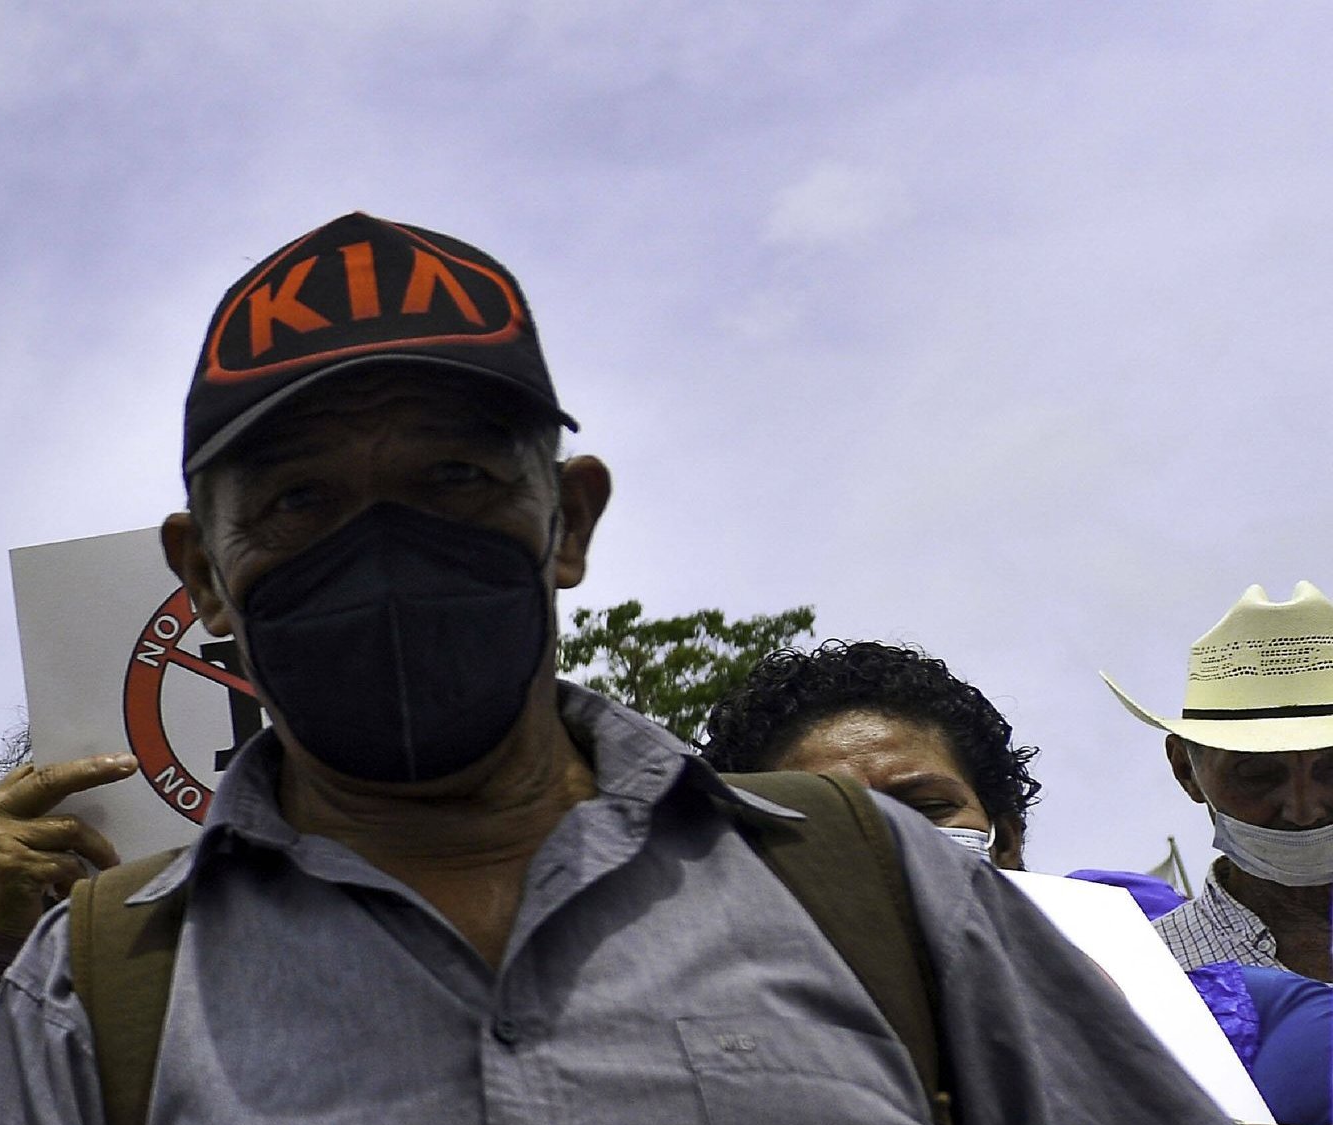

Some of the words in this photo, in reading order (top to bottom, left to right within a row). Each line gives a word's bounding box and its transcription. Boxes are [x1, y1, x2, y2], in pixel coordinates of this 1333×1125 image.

[246, 241, 486, 358] KIA
[137, 615, 179, 667] NO
[154, 766, 202, 810] NO
